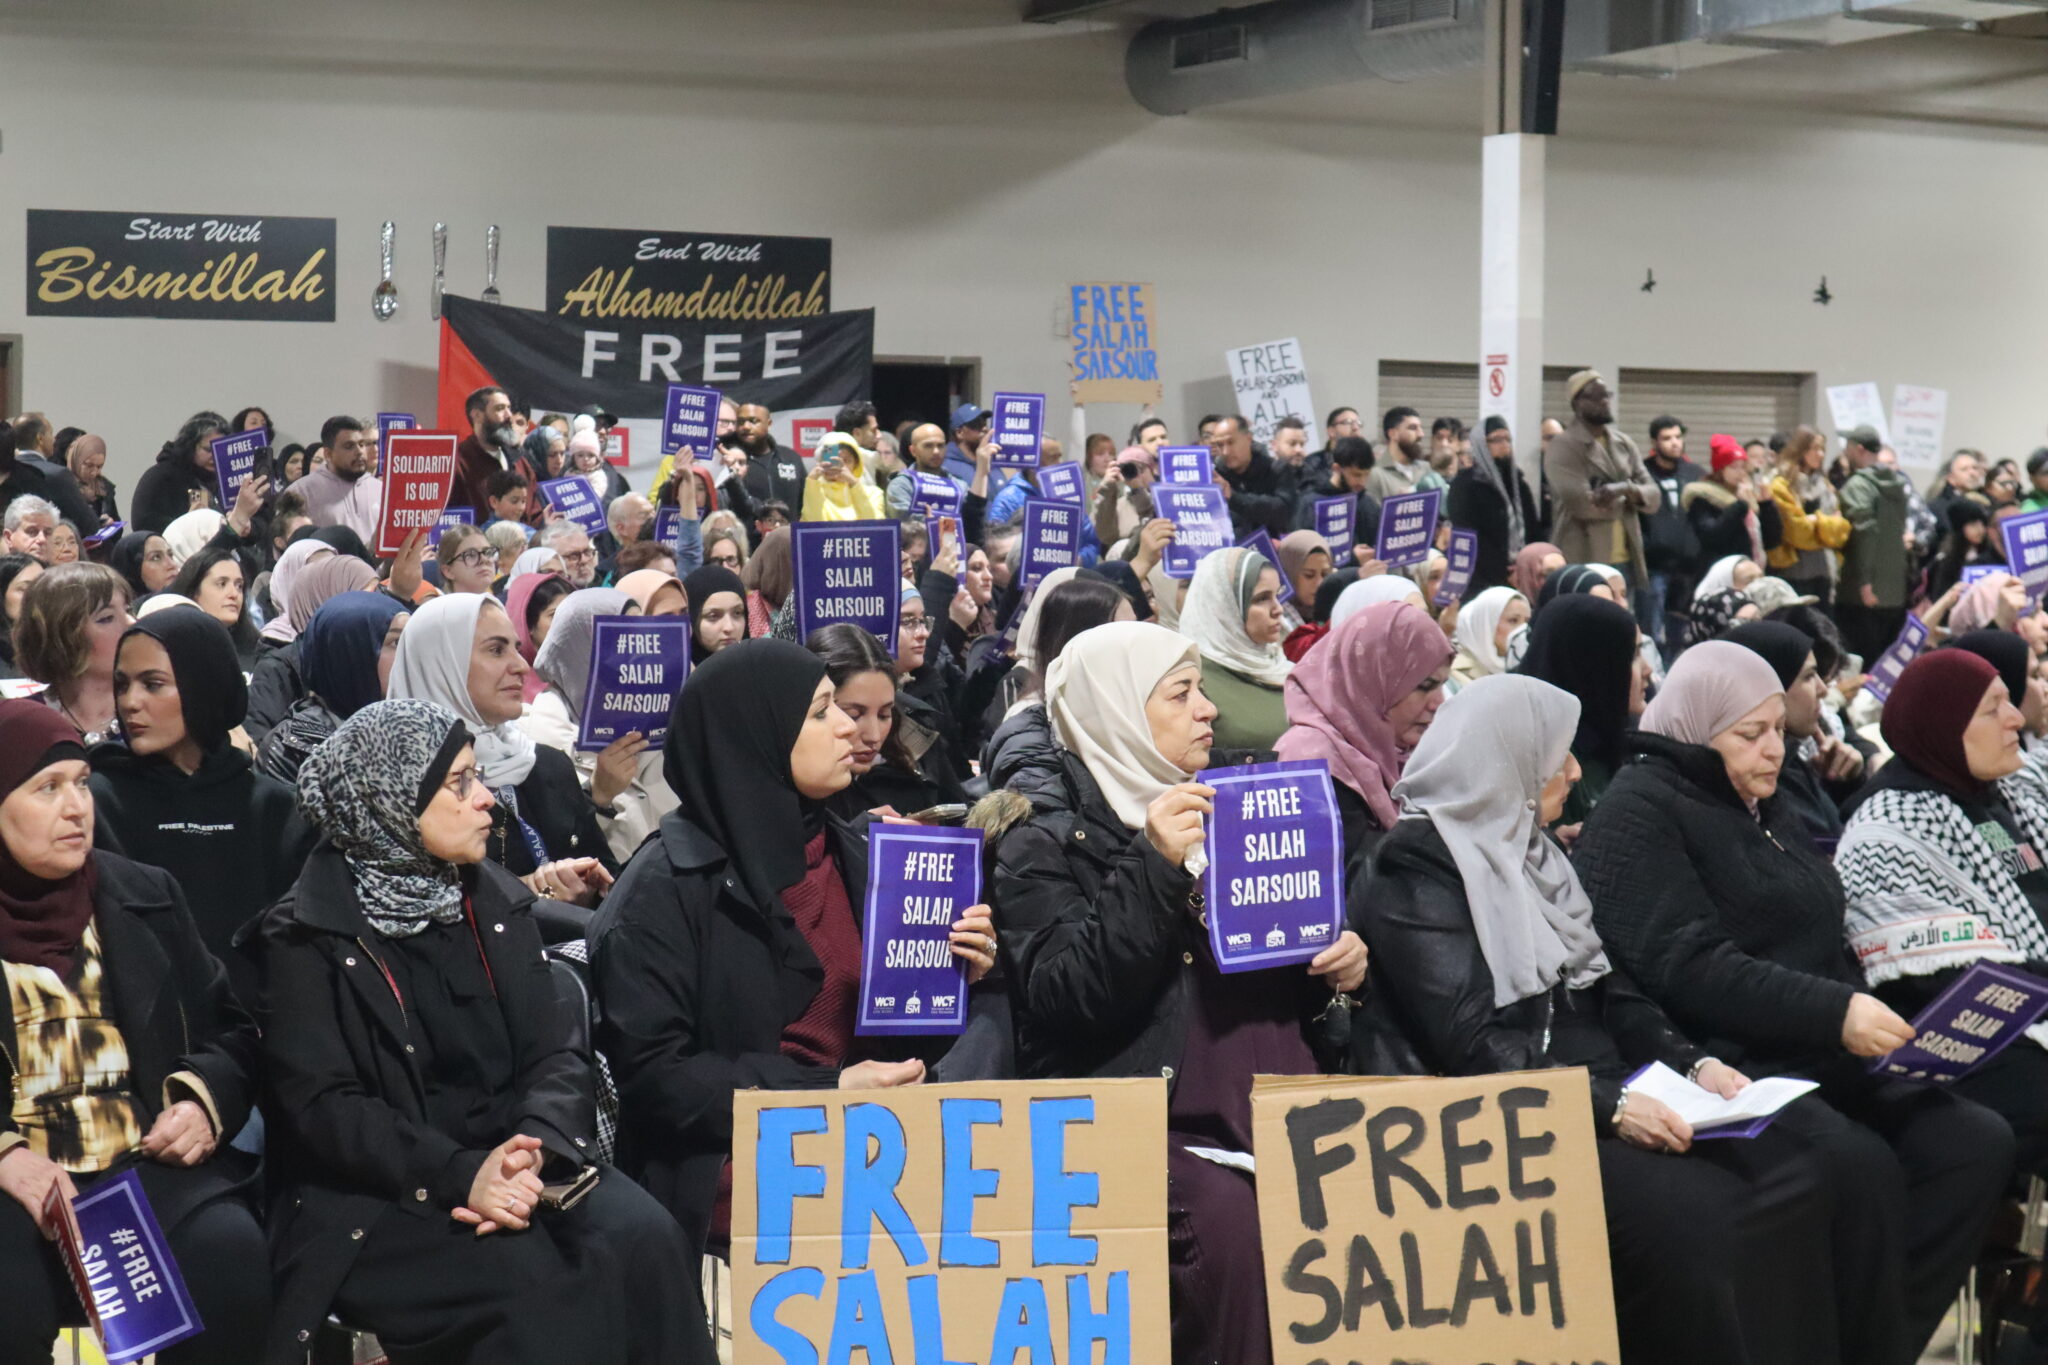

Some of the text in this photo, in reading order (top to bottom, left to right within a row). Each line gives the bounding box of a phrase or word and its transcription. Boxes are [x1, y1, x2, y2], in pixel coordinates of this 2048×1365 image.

[125, 218, 262, 243] Start With
[635, 238, 762, 263] End With
[35, 246, 326, 302] Bismillah
[559, 266, 827, 320] Alhamdulillah
[1071, 285, 1145, 323] FREE
[1072, 323, 1149, 350] SALAH
[581, 329, 803, 381] FREE
[1073, 349, 1159, 381] SARSOUR
[1239, 342, 1296, 375] FREE
[680, 394, 706, 407] #FREE
[1005, 402, 1030, 414] #FREE
[1254, 398, 1300, 425] ALL
[679, 410, 705, 422] SALAH
[1005, 417, 1030, 430] SALAH
[671, 423, 708, 438] SARSOUR
[227, 439, 253, 456] #FREE
[393, 455, 452, 474] SOLIDARITY
[1172, 454, 1198, 467] #FREE
[405, 483, 439, 500] IS OUR
[555, 482, 579, 495] #FREE
[561, 493, 586, 507] SALAH
[1172, 493, 1207, 508] #FREE
[1396, 499, 1425, 515] #FREE
[1041, 509, 1069, 525] #FREE
[1178, 511, 1212, 525] SALAH
[1394, 516, 1424, 532] SALAH
[1041, 529, 1069, 544] SALAH
[1174, 530, 1223, 547] SARSOUR
[823, 537, 872, 559] #FREE
[1033, 547, 1073, 565] SARSOUR
[825, 567, 874, 588] SALAH
[815, 596, 885, 618] SARSOUR
[617, 634, 662, 655] #FREE
[619, 664, 664, 684] SALAH
[603, 692, 671, 713] SARSOUR
[1241, 786, 1302, 820] #FREE
[158, 822, 234, 831] FREE PALESTINE
[1244, 828, 1306, 863] SALAH
[904, 851, 955, 882] #FREE
[1230, 870, 1321, 907] SARSOUR
[902, 895, 953, 925] SALAH
[1974, 982, 2030, 1014] #FREE
[1950, 1009, 2005, 1039] SALAH
[1913, 1030, 1986, 1064] SARSOUR
[1285, 1087, 1557, 1232] FREE
[754, 1095, 1099, 1269] FREE
[109, 1227, 162, 1303] #FREE
[1282, 1209, 1566, 1344] SALAH
[749, 1266, 1131, 1365] SALAH
